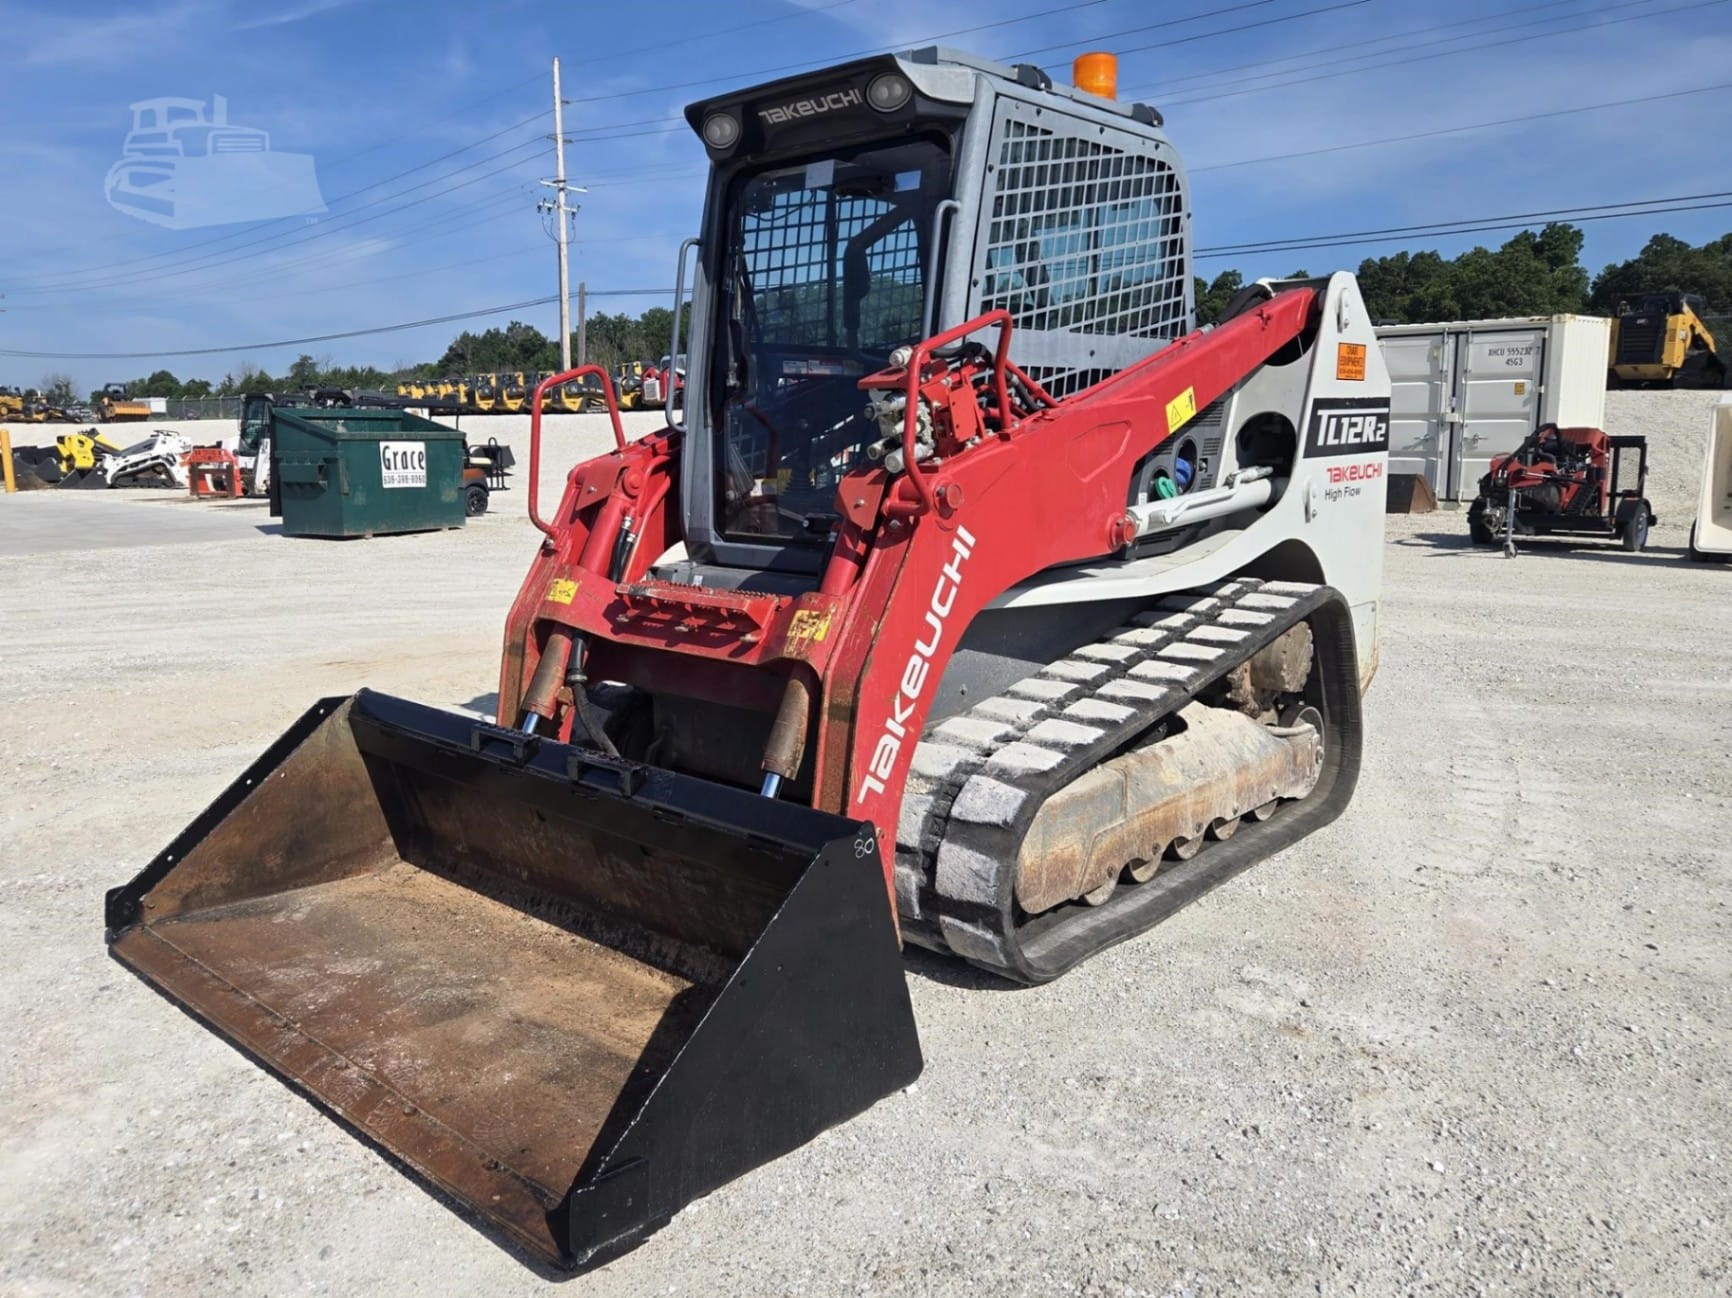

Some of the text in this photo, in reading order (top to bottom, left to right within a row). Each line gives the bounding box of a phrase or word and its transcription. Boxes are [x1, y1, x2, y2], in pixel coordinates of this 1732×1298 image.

[382, 445, 425, 470] Grace
[1324, 486, 1361, 501] High Flow
